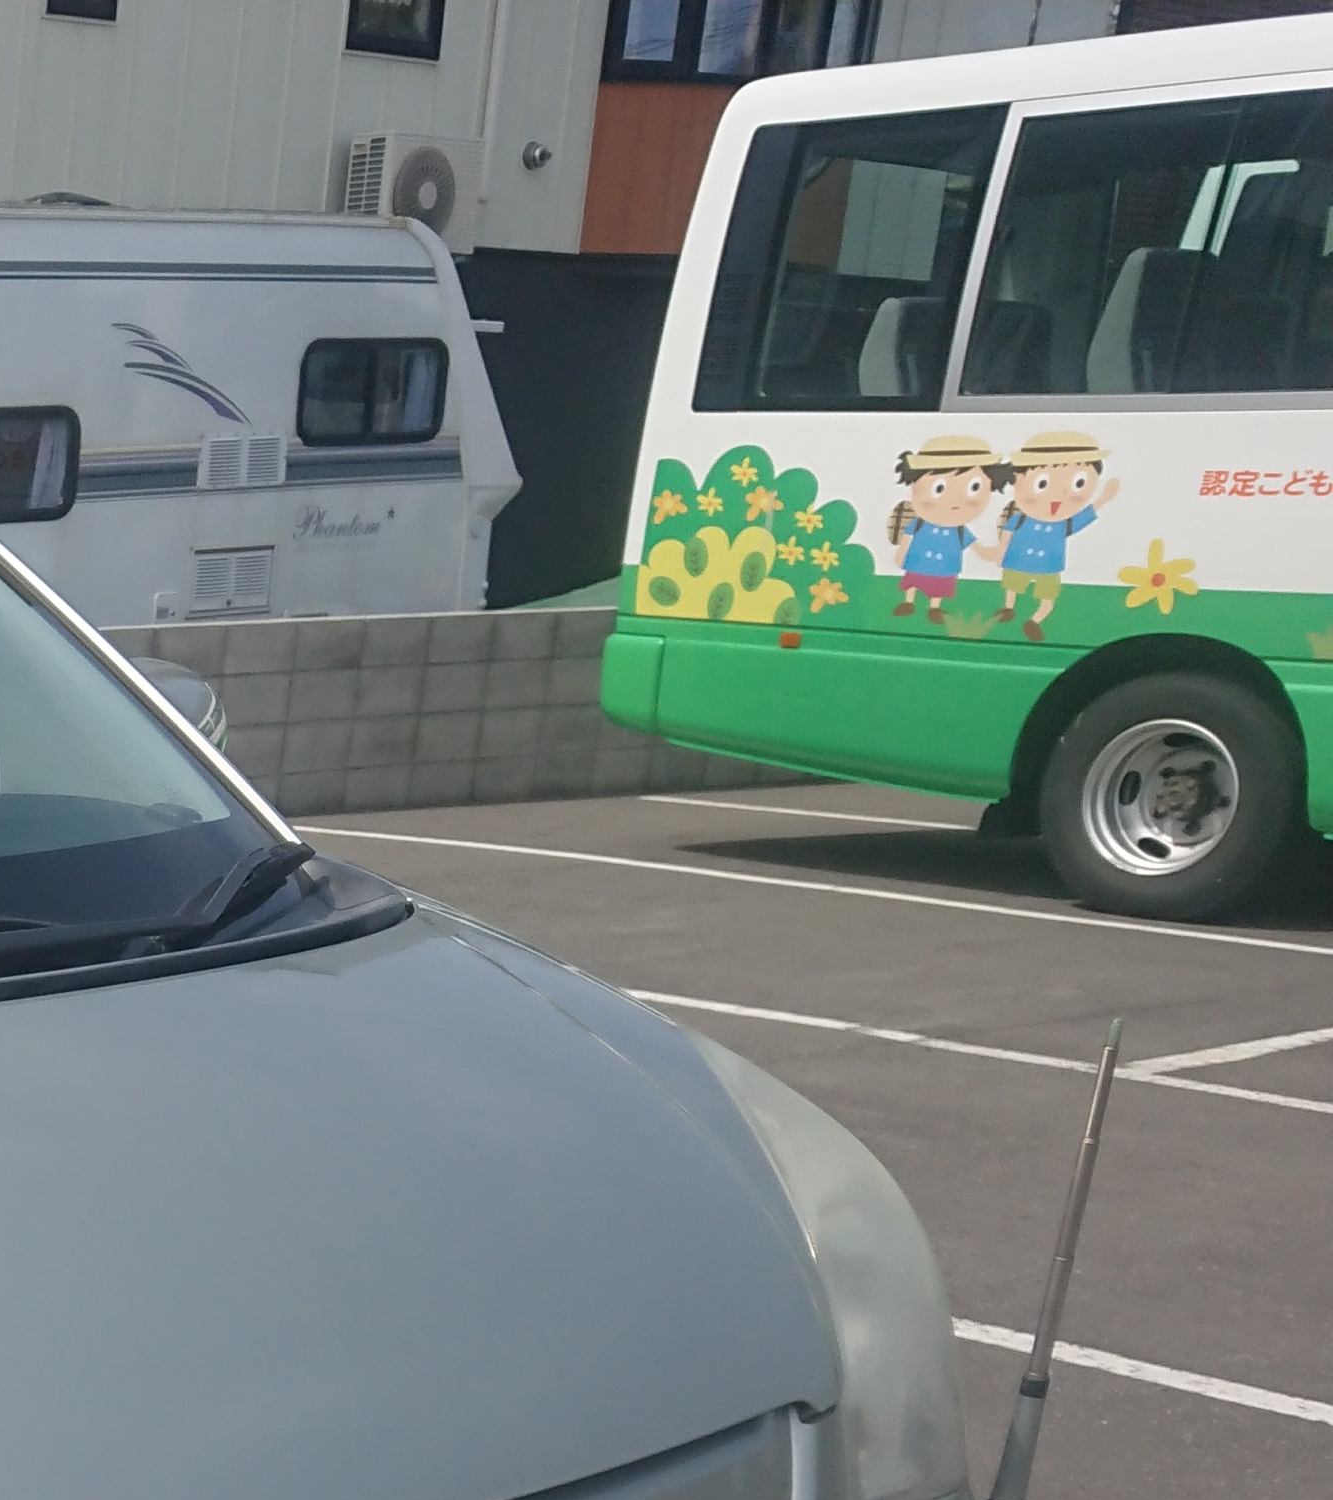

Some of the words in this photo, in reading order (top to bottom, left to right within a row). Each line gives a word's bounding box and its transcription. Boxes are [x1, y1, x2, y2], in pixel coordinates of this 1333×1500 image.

[1199, 469, 1333, 497] 認定こども
[292, 505, 380, 540] Phantom
